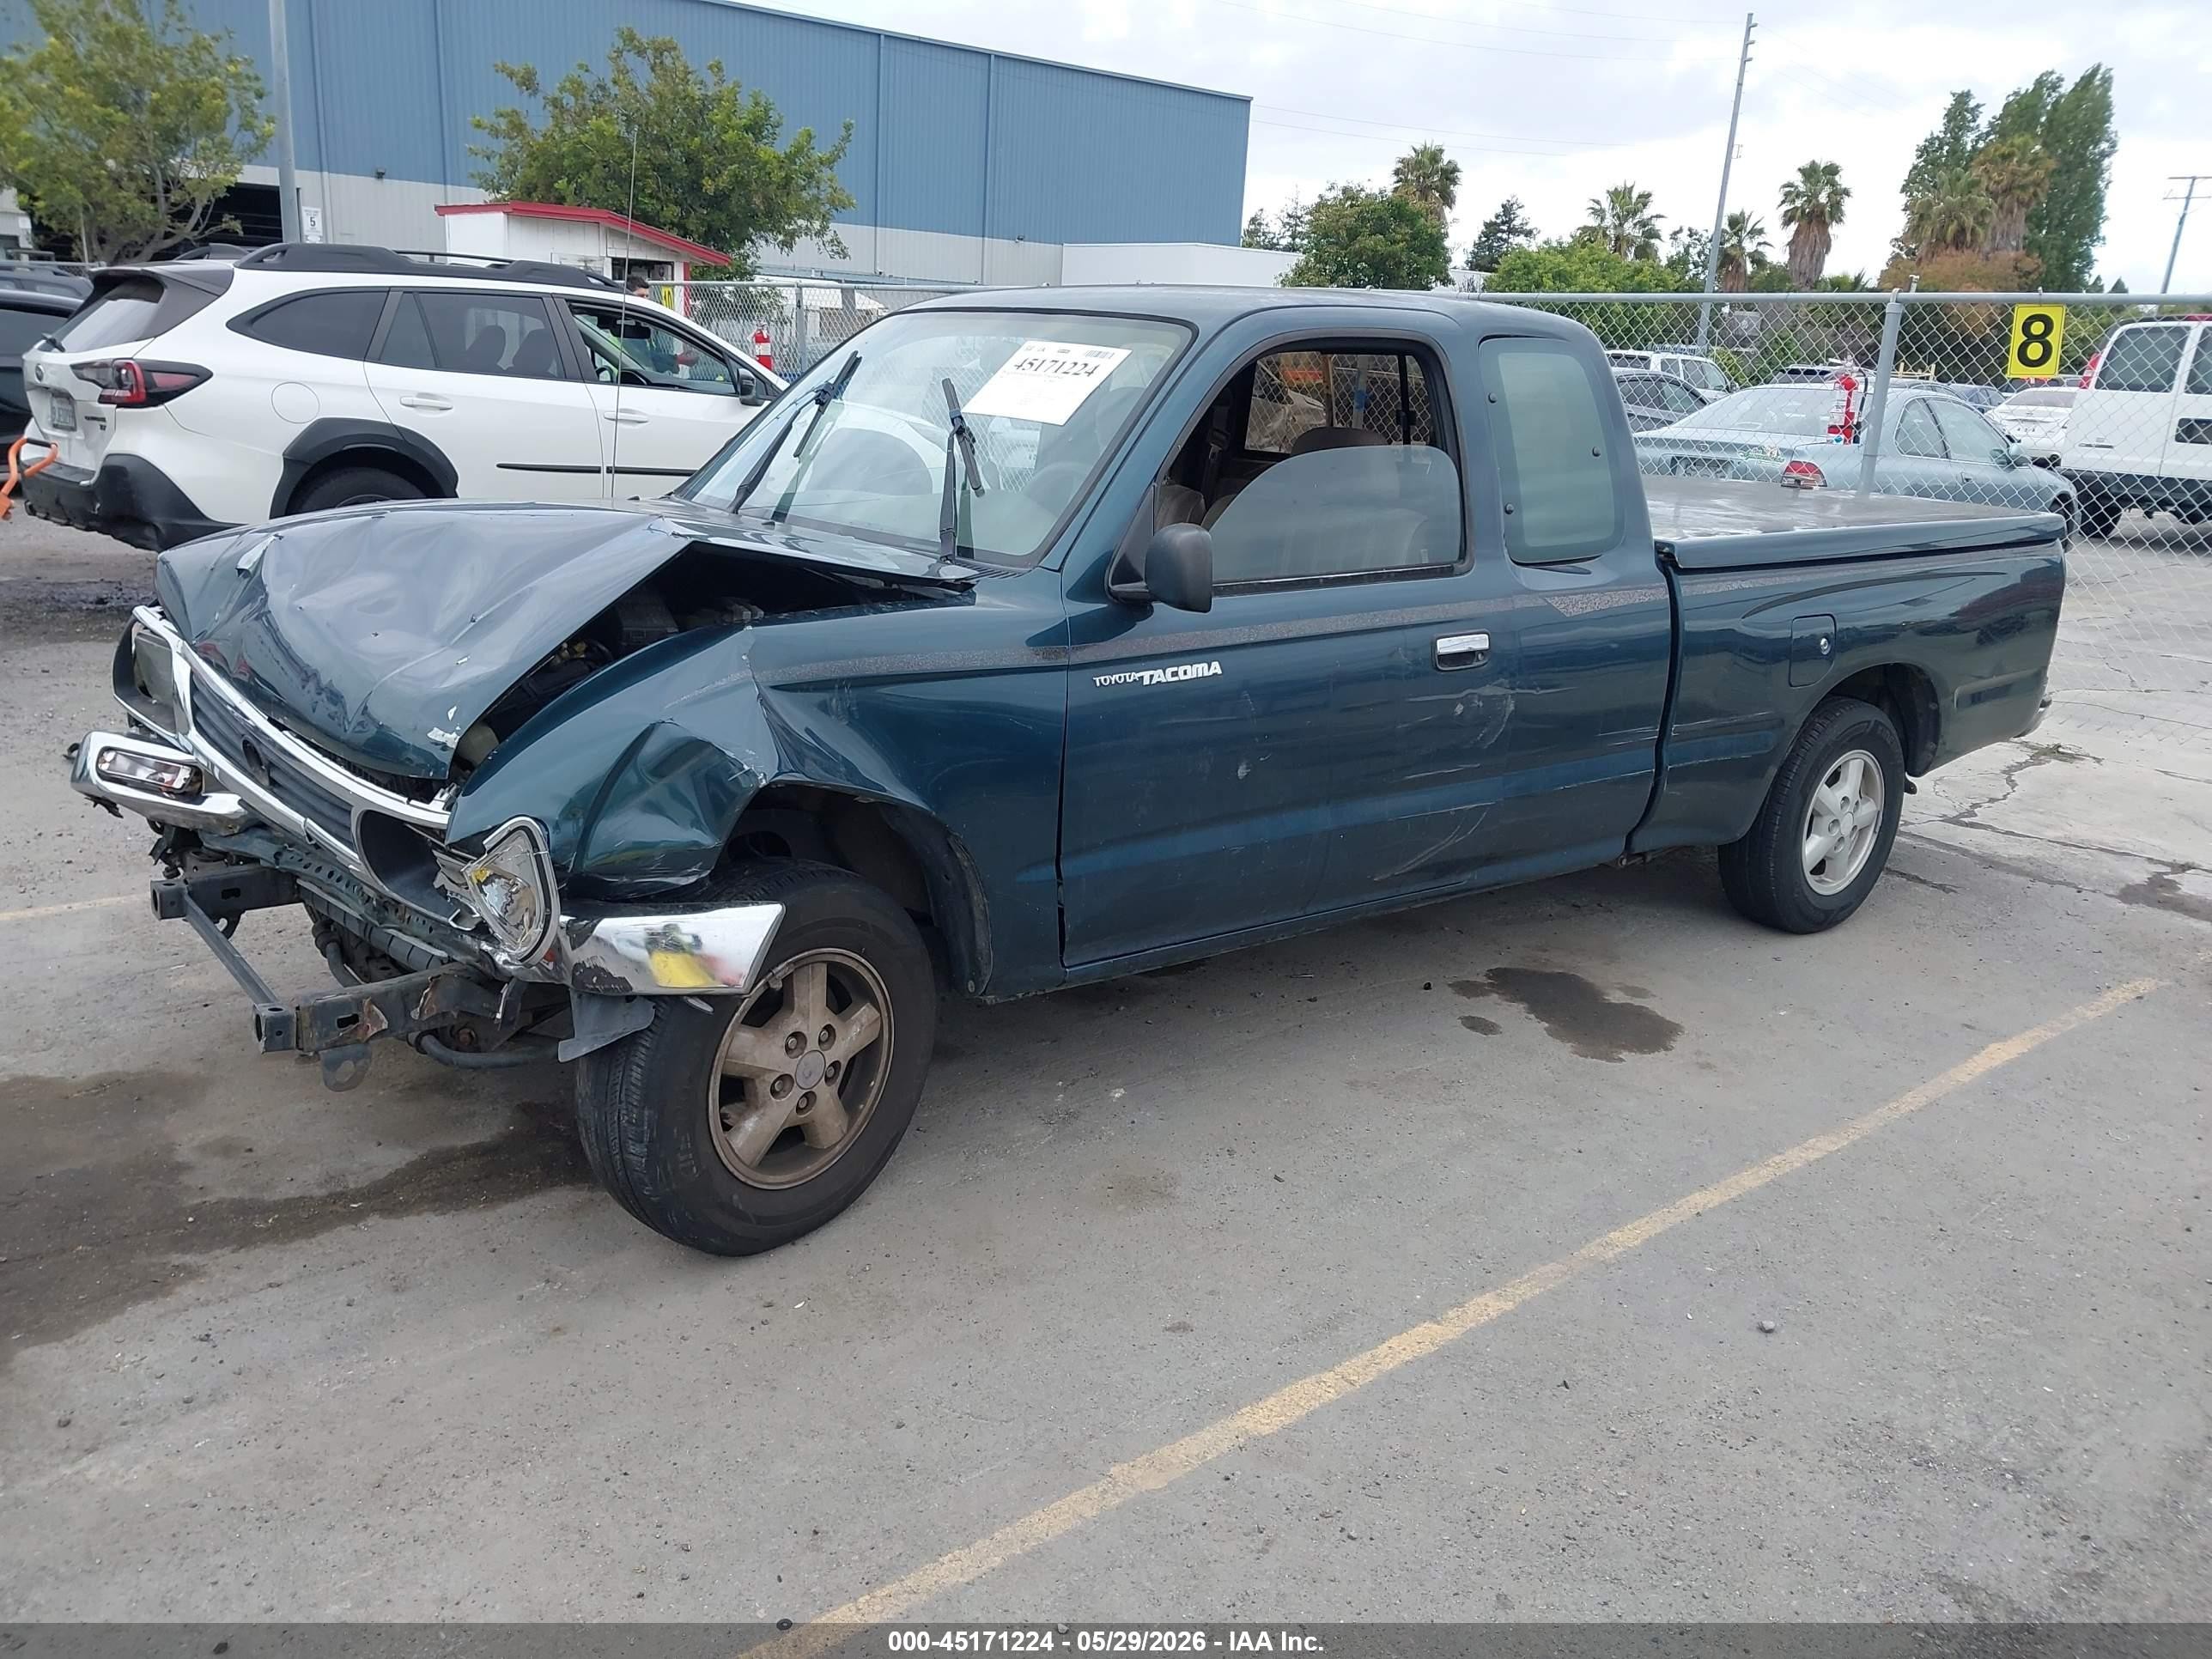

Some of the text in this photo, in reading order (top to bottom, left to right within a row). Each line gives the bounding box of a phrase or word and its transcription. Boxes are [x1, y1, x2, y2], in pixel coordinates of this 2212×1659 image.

[310, 216, 316, 227] 5
[2017, 313, 2055, 368] 8
[1014, 358, 1100, 377] 45171224
[1093, 661, 1223, 687] TOYOTA TACOMA
